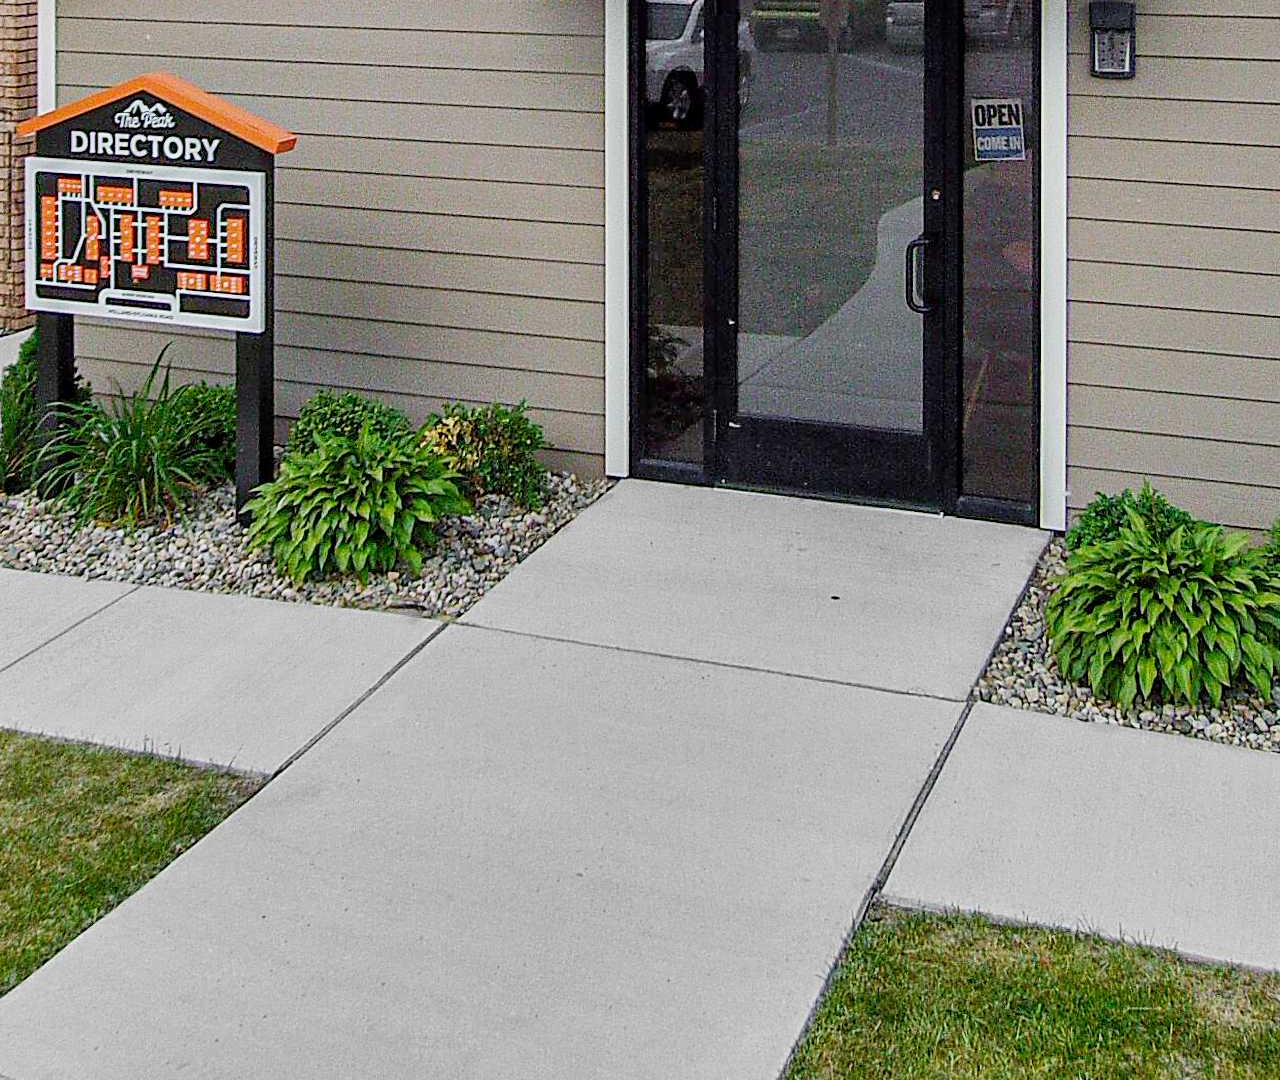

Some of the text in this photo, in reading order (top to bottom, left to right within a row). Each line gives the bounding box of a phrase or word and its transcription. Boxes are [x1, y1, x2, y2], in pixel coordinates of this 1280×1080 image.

[114, 110, 175, 129] The Peak
[974, 103, 1020, 127] OPEN
[70, 130, 220, 162] DIRECTORY
[977, 135, 1021, 151] COME IN
